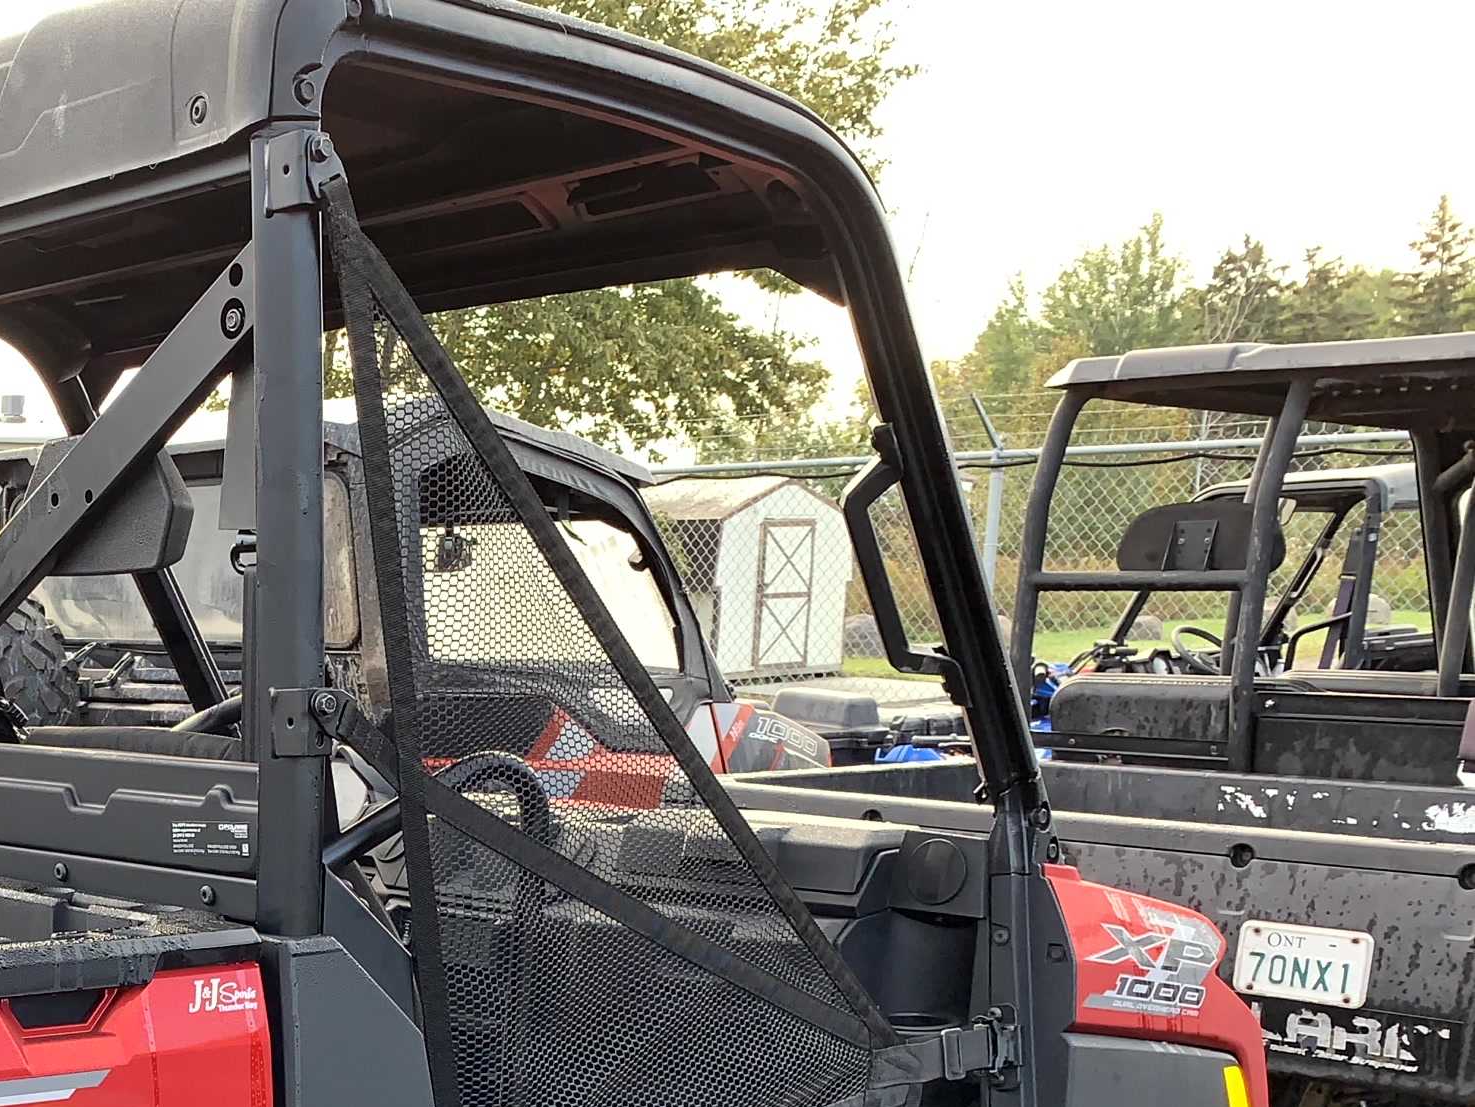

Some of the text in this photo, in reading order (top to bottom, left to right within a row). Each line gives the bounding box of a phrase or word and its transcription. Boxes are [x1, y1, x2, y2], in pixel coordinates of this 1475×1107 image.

[756, 716, 818, 756] 1000
[1084, 922, 1218, 975] XP
[188, 977, 257, 1013] J&J Sports
[1115, 973, 1206, 1009] 1000
